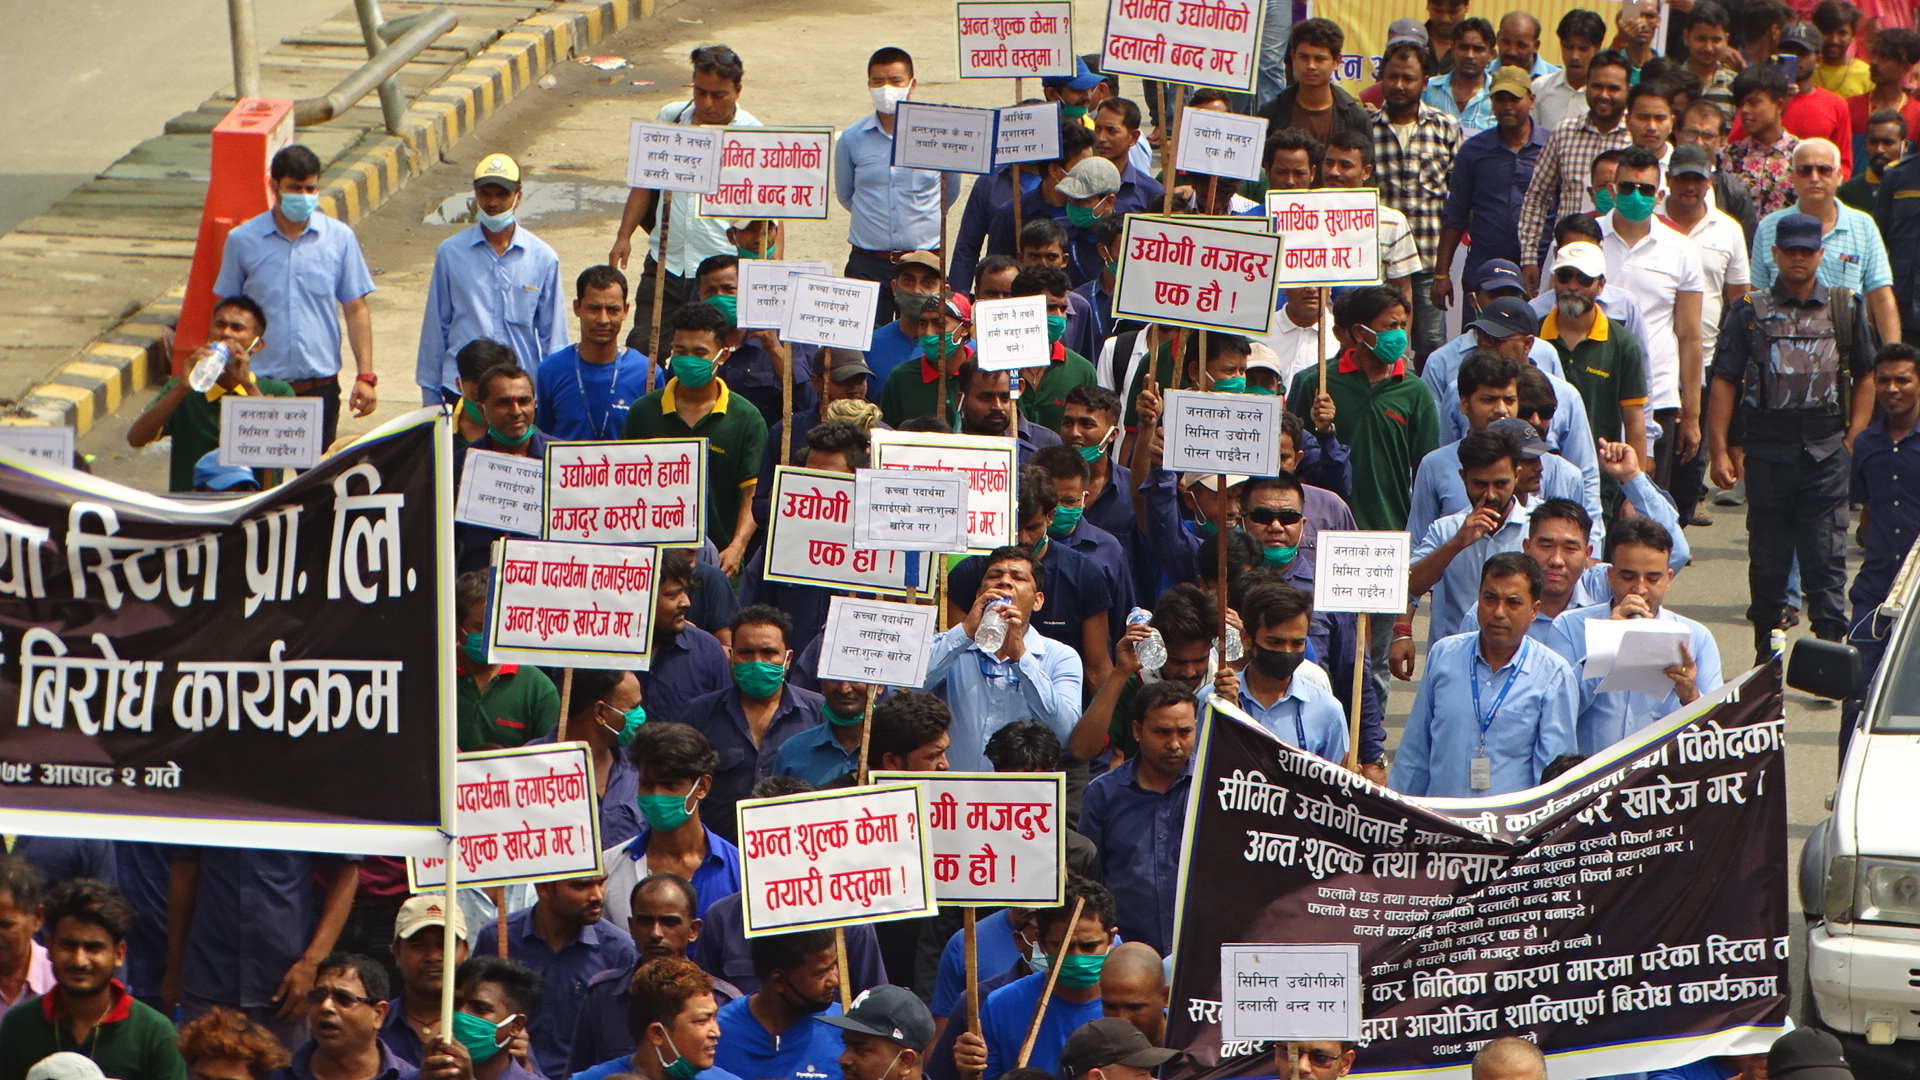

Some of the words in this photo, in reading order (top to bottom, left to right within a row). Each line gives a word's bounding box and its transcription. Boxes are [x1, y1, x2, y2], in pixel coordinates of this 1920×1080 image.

[1029, 11, 1057, 34] केमा
[971, 43, 1008, 68] तयारी
[1011, 49, 1052, 72] वस्तुमा
[1108, 33, 1168, 64] दलाली
[1170, 43, 1207, 71] बन्द
[1210, 48, 1238, 75] गर
[1003, 111, 1033, 122] आर्थिक
[642, 132, 669, 145] उद्योग
[687, 136, 711, 149] नचले
[1001, 128, 1036, 142] सुशासन
[1194, 126, 1222, 140] उद्योगी
[1226, 133, 1253, 147] मजदुर
[647, 151, 668, 162] हामी
[673, 154, 702, 168] मजदुर
[760, 141, 822, 169] उद्योगीको
[1205, 147, 1221, 158] एक
[643, 168, 669, 180] कसरी
[758, 185, 787, 206] बन्द
[791, 185, 814, 207] गर
[1324, 209, 1375, 237] सुशासन
[1131, 233, 1195, 266] उद्योगी
[1200, 246, 1273, 281] मजदुर
[1285, 247, 1327, 269] कायम
[1331, 247, 1352, 269] गर
[1154, 280, 1193, 305] एक
[1196, 280, 1222, 313] हौ
[240, 408, 280, 420] जनताको
[284, 408, 307, 420] करले
[1185, 406, 1231, 420] जनताको
[1236, 409, 1263, 422] करले
[1185, 423, 1220, 439] सिमित
[1225, 428, 1261, 442] उद्योगी
[1184, 444, 1210, 459] पोस्न
[559, 454, 610, 488] उद्योगनै
[614, 454, 653, 487] नचले
[657, 453, 691, 487] हामी
[884, 485, 908, 496] कच्चा
[913, 485, 946, 498] पदार्थमा
[782, 486, 851, 523] उद्योगी
[871, 502, 912, 514] लगाईएको
[916, 503, 958, 519] अन्त:शुल्क
[552, 507, 600, 538] मजदुर
[604, 498, 647, 531] कसरी
[651, 496, 686, 530] चल्ने
[889, 520, 913, 531] खारेज
[918, 522, 931, 532] गर
[979, 511, 996, 536] गर
[66, 501, 222, 610] स्टिल
[241, 504, 308, 619] प्रा.
[327, 463, 417, 604] लि.
[809, 539, 847, 566] एक
[1333, 544, 1370, 557] जनताको
[1374, 545, 1395, 558] करले
[505, 560, 539, 586] कच्चा
[541, 555, 590, 589] पदार्थमा
[591, 558, 652, 595] लगाईएको
[1332, 563, 1361, 577] सिमित
[1364, 565, 1394, 578] उद्योगी
[1332, 583, 1353, 597] पोस्न
[573, 601, 611, 637] खारेज
[613, 611, 634, 638] गर
[853, 610, 878, 622] कच्चा
[881, 613, 915, 626] पदार्थमा
[859, 628, 901, 643] लगाईएको
[887, 650, 912, 662] खारेज
[17, 627, 164, 736] बिरोध
[171, 639, 403, 738] कार्यक्रम
[863, 666, 876, 676] गर
[144, 760, 183, 788] गते
[514, 763, 586, 808] लगाईएको
[1620, 774, 1699, 819] खारेज
[1706, 771, 1747, 804] गर
[1217, 769, 1289, 818] सीमित
[1293, 794, 1408, 848] उद्योगीलाई
[855, 807, 898, 845] केमा
[966, 802, 1052, 840] मजदुर
[502, 820, 546, 861] खारेज
[550, 826, 575, 856] गर
[1620, 828, 1653, 846] फिर्ता
[1656, 826, 1675, 839] गर
[1664, 840, 1684, 853] गर
[968, 843, 998, 886] हौ
[1371, 852, 1419, 879] तथा
[1426, 852, 1509, 884] भन्सार
[765, 866, 823, 911] तयारी
[829, 867, 891, 908] वस्तुमा
[1487, 880, 1530, 897] भन्सार
[1580, 867, 1613, 883] फिर्ता
[1615, 865, 1633, 879] गर
[1307, 903, 1346, 917] फलामे
[1348, 907, 1369, 919] छड
[1373, 909, 1381, 921] र
[1384, 909, 1429, 923] वायर्सको
[1478, 896, 1519, 914] दलाली
[1523, 893, 1548, 906] बन्द
[1551, 890, 1572, 902] गर
[1318, 887, 1357, 902] फलामे
[1359, 891, 1379, 903] छड
[1383, 893, 1405, 905] तथा
[1408, 894, 1453, 908] वायर्सको
[1487, 910, 1541, 926] वातावरण
[1420, 939, 1453, 954] उद्योगी
[1456, 931, 1494, 946] मजदुर
[1499, 928, 1520, 941] एक
[1523, 924, 1538, 940] हौ
[1449, 947, 1476, 963] हामी
[1480, 946, 1521, 960] मजदुर
[1523, 940, 1560, 956] कसरी
[1237, 971, 1279, 988] सिमित
[1285, 972, 1346, 988] उद्योगीको
[1372, 979, 1407, 1002] कर
[1412, 967, 1487, 999] नितिका
[1494, 962, 1560, 992] कारण
[1566, 954, 1634, 981] मारमा
[1640, 943, 1700, 971] परेका
[1706, 934, 1766, 965] स्टिल
[1237, 996, 1278, 1012] दलाली
[1317, 1000, 1336, 1012] गर
[1404, 1004, 1499, 1038] आयोजित
[1504, 994, 1604, 1026] शान्तिपूर्ण
[1611, 981, 1672, 1013] बिरोध
[1678, 973, 1778, 1004] कार्यक्रम
